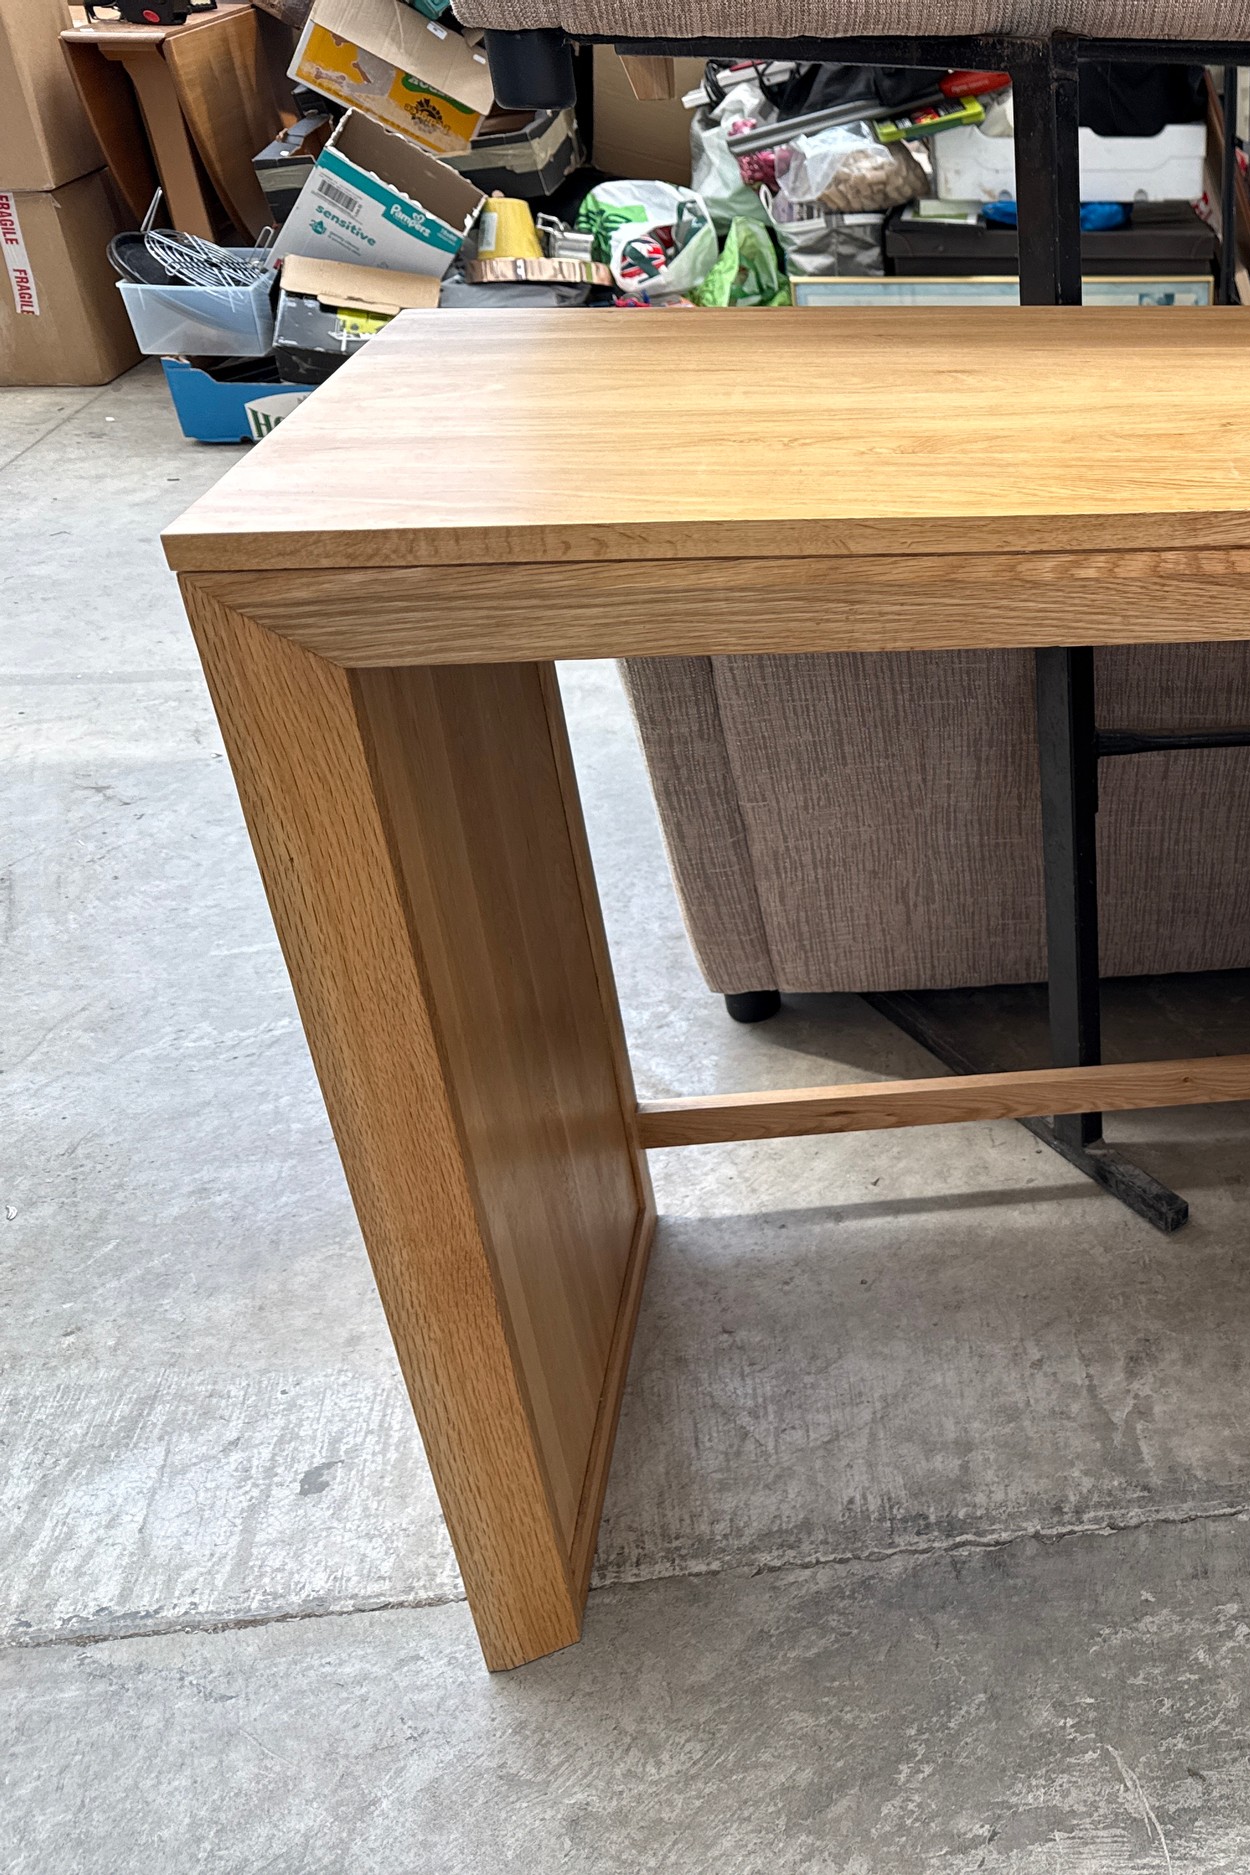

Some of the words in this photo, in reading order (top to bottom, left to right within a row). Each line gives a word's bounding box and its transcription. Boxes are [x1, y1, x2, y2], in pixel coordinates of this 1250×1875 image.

[316, 204, 376, 246] sensitive
[390, 203, 431, 237] Pampers
[13, 268, 35, 315] FRAGILE
